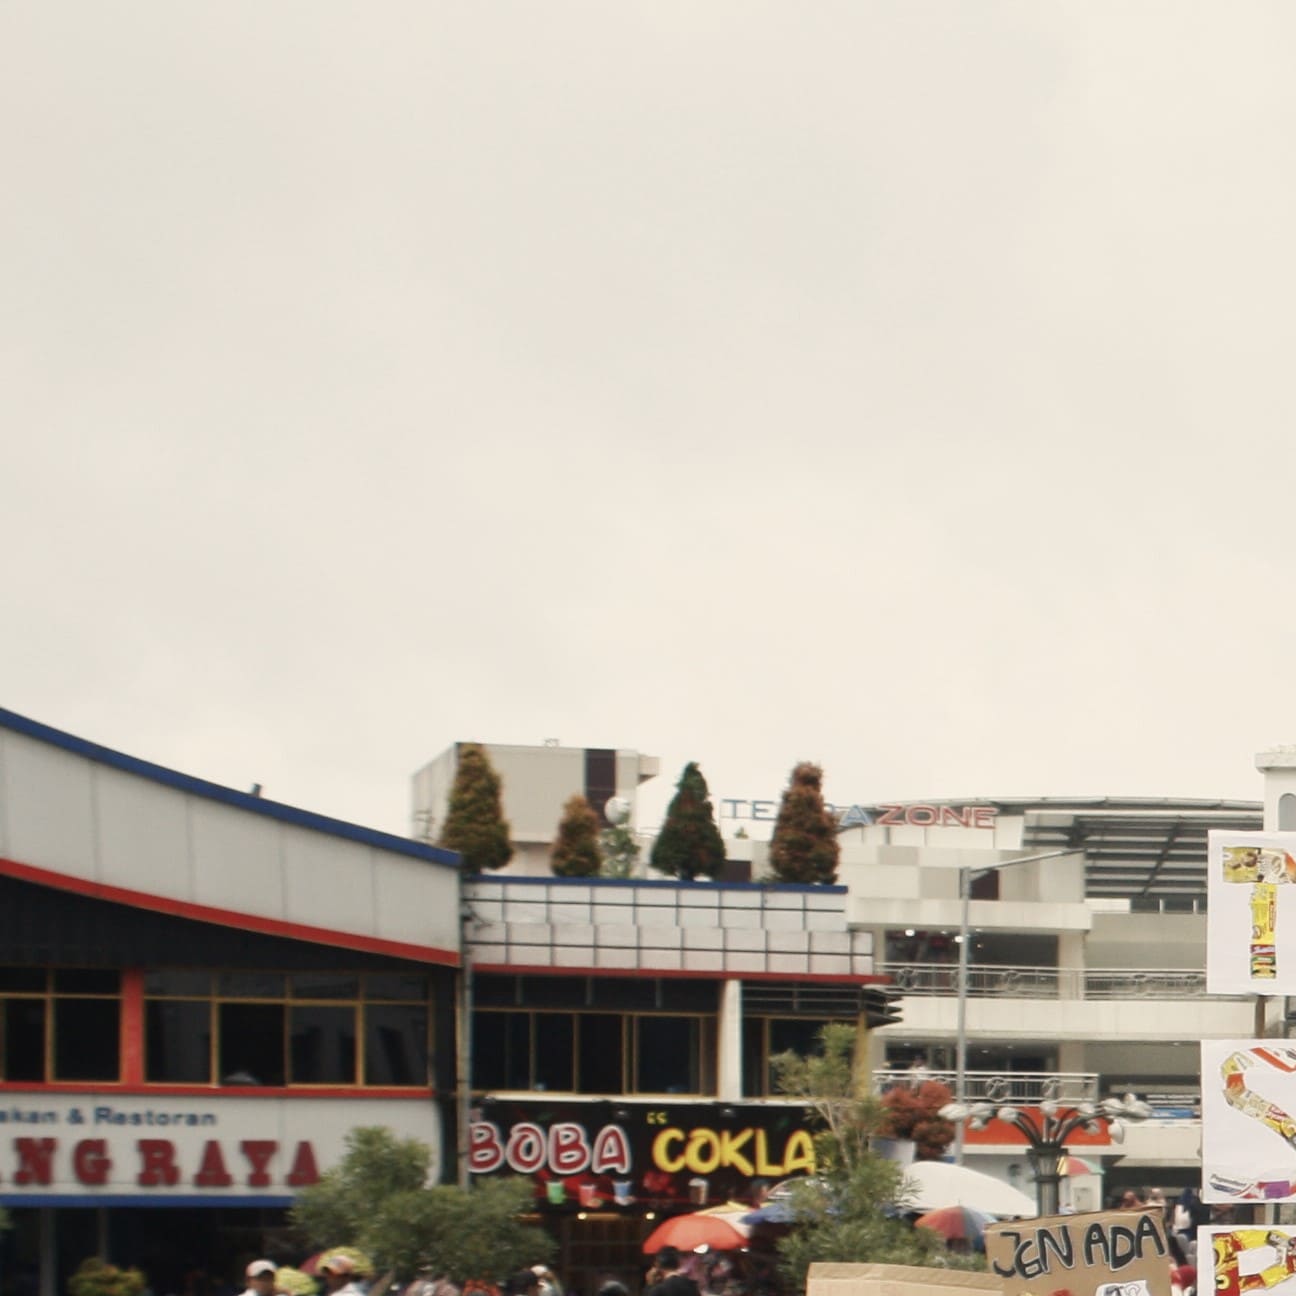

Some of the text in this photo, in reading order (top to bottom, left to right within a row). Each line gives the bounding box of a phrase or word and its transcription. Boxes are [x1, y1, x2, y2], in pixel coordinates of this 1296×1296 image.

[721, 798, 1000, 830] TEA ZONE
[68, 1107, 85, 1125] &
[94, 1106, 217, 1127] Restoran
[137, 1138, 322, 1188] RAYA
[468, 1121, 632, 1175] BOBA
[651, 1126, 816, 1177] COKLA
[1084, 1214, 1166, 1272] ADA
